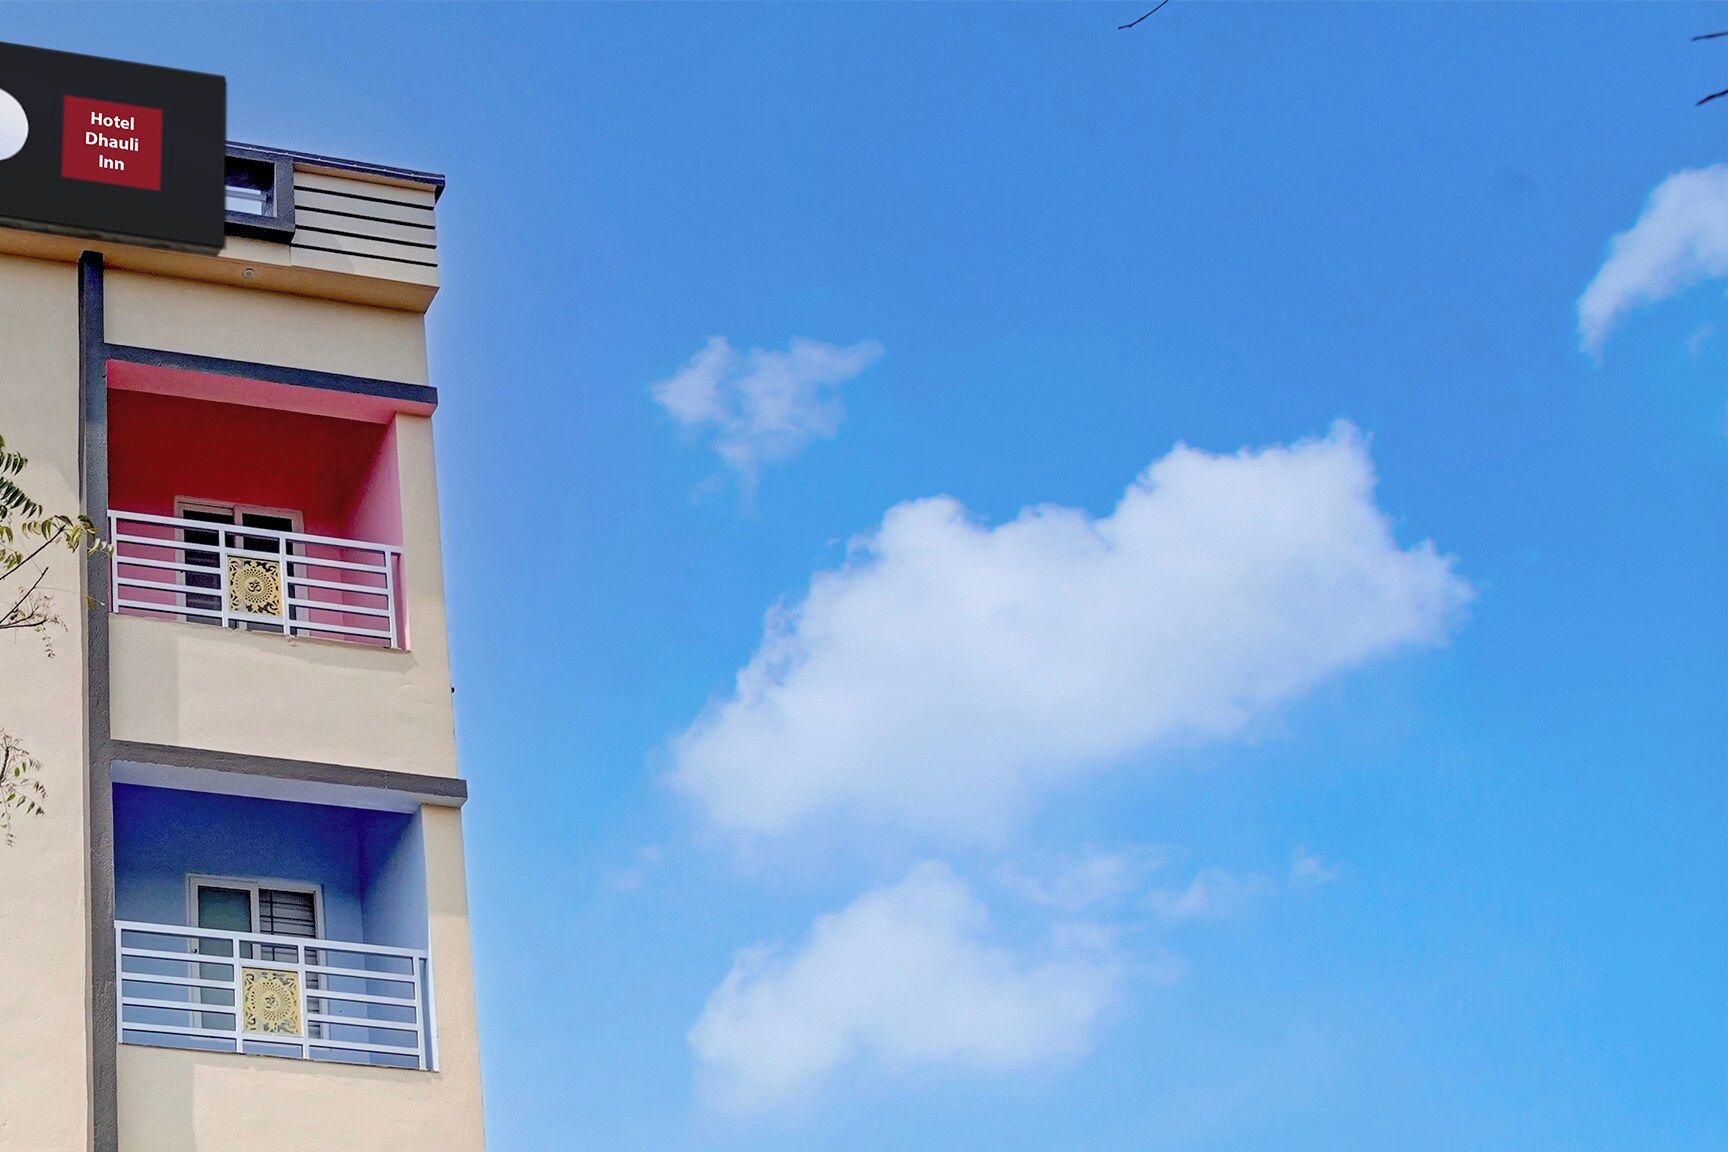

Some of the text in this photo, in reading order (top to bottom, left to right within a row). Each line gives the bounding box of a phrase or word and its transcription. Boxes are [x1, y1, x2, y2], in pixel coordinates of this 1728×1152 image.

[91, 112, 134, 130] Hotel
[85, 131, 139, 151] Dhauli
[99, 154, 125, 171] Inn
